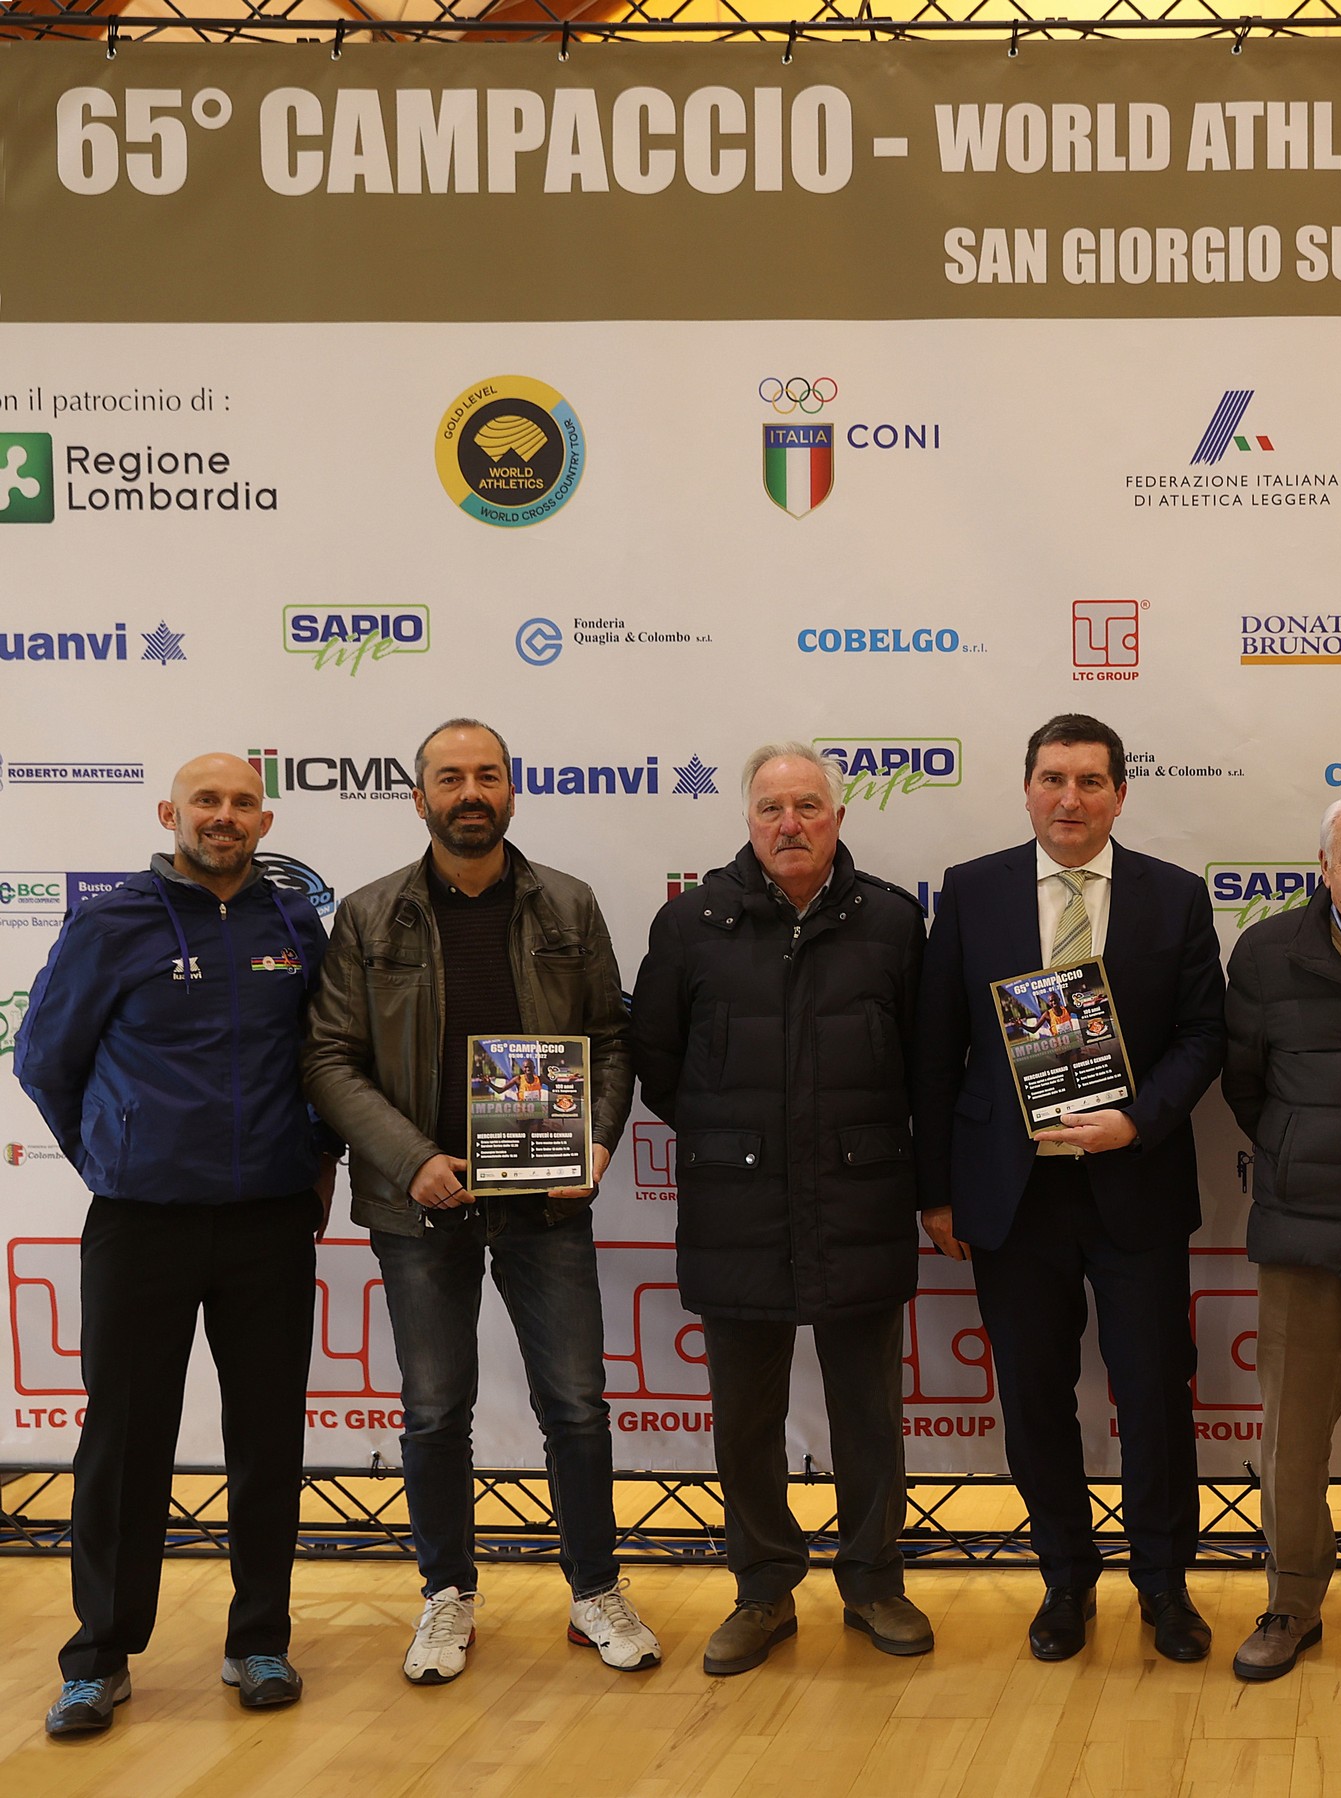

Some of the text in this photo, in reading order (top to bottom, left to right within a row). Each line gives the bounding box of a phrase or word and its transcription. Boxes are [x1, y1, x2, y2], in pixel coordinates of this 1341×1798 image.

[55, 86, 233, 196] 65°
[259, 84, 854, 196] CAMPACCIO
[934, 101, 1172, 174] WORLD
[943, 226, 1048, 285] SAN
[1062, 224, 1282, 285] GIORGIO
[28, 386, 42, 411] il
[53, 386, 182, 419] patrocinio
[191, 387, 214, 411] di
[444, 385, 498, 440] GOLD LEVEL
[768, 429, 828, 444] ITALIA
[847, 423, 941, 449] CONI
[66, 446, 230, 482] Regione
[480, 418, 579, 522] WORLD CROSS COUNTRY TOUR
[488, 467, 534, 478] WORLD
[478, 479, 544, 490] ATHLETICS
[1125, 473, 1339, 488] FEDERAZIONE ITALIANA
[66, 482, 278, 511] Lombardia
[1134, 493, 1331, 506] DI ATLETICA LEGGERA
[291, 614, 424, 643] SAPIO
[573, 617, 625, 629] Fonderia
[573, 631, 620, 646] Quaglia
[637, 631, 691, 643] Colombo
[797, 628, 988, 653] COBELGO s.r.l.
[1073, 671, 1139, 681] LTC GROUP
[821, 747, 955, 776] SAPIO
[1168, 765, 1222, 776] Colombo
[8, 768, 144, 779] ROBERTO MARTEGANI
[285, 757, 416, 791] ICMA
[512, 757, 659, 795] luanvi
[340, 792, 416, 800] SAN GIORGI
[18, 884, 60, 896] BCC
[78, 881, 113, 892] Busto
[1213, 872, 1322, 900] SAPI
[1031, 969, 1084, 991] CAMPACCIO
[509, 1043, 565, 1053] CAMPACCIO
[636, 1191, 657, 1200] LTC
[16, 1408, 66, 1428] LTC
